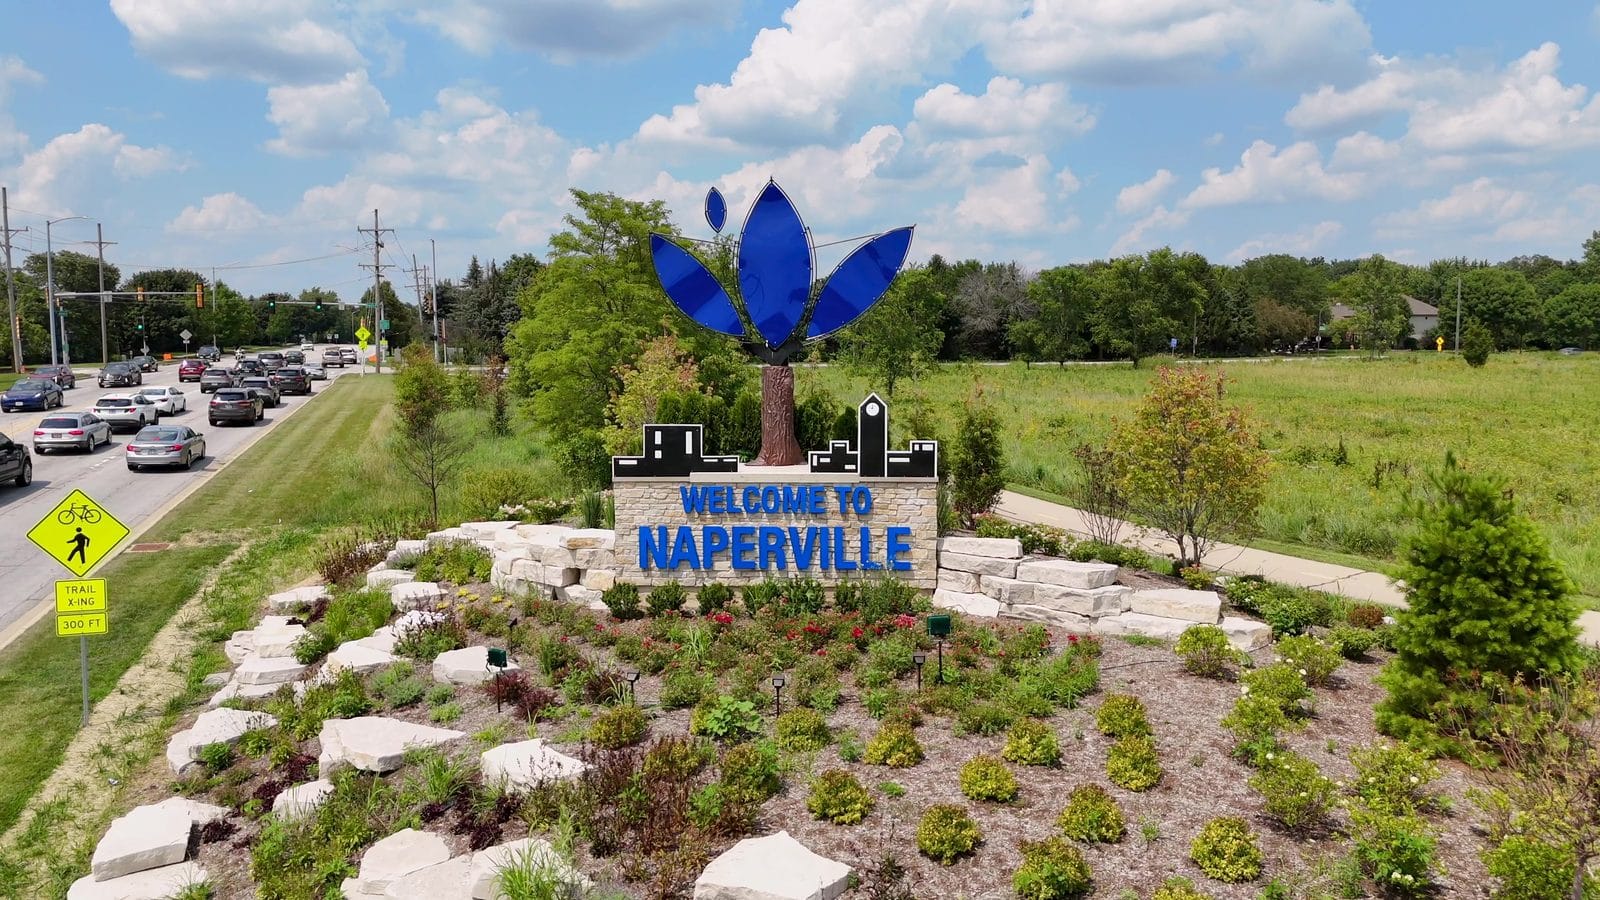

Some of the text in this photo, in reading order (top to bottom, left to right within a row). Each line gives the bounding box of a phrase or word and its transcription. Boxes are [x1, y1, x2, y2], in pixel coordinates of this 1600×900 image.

[680, 485, 873, 515] WELCOME TO
[638, 526, 912, 571] NAPERVILLE
[65, 586, 96, 594] TRAIL
[68, 598, 95, 606] X-ING
[64, 619, 100, 629] 300 FT
